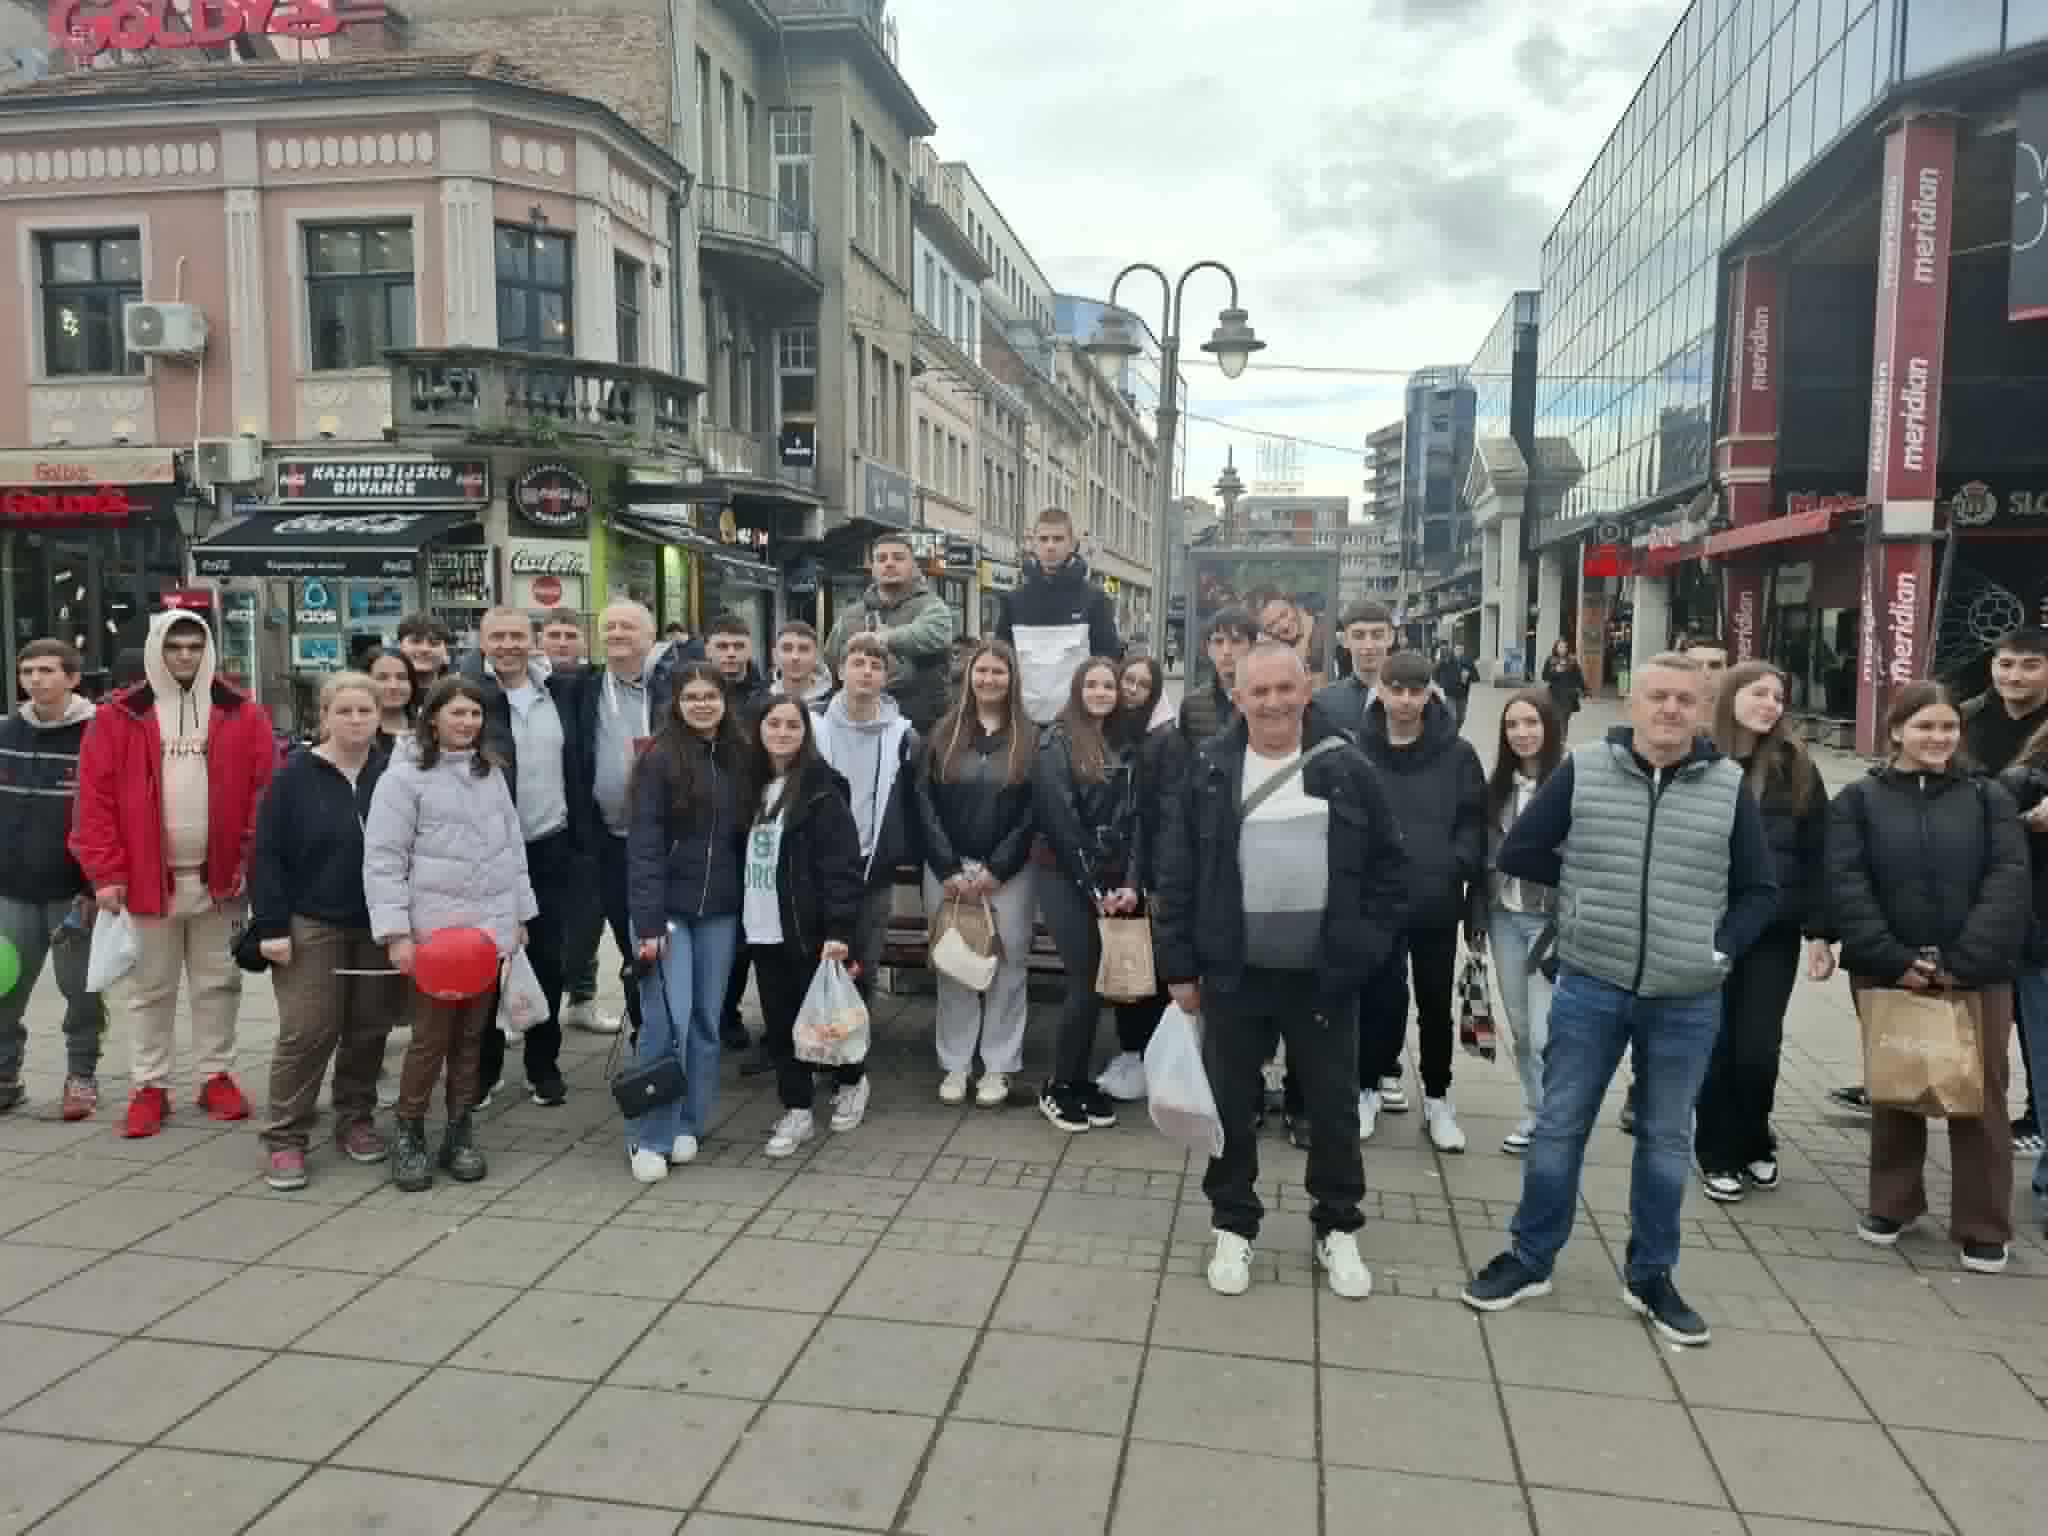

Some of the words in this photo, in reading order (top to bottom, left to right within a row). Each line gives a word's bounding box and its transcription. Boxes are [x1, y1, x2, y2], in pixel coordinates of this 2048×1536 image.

[1911, 166, 1940, 284] meridian
[1747, 306, 1769, 392] meridian
[1900, 357, 1929, 473] meridian
[1888, 572, 1917, 686] meridian
